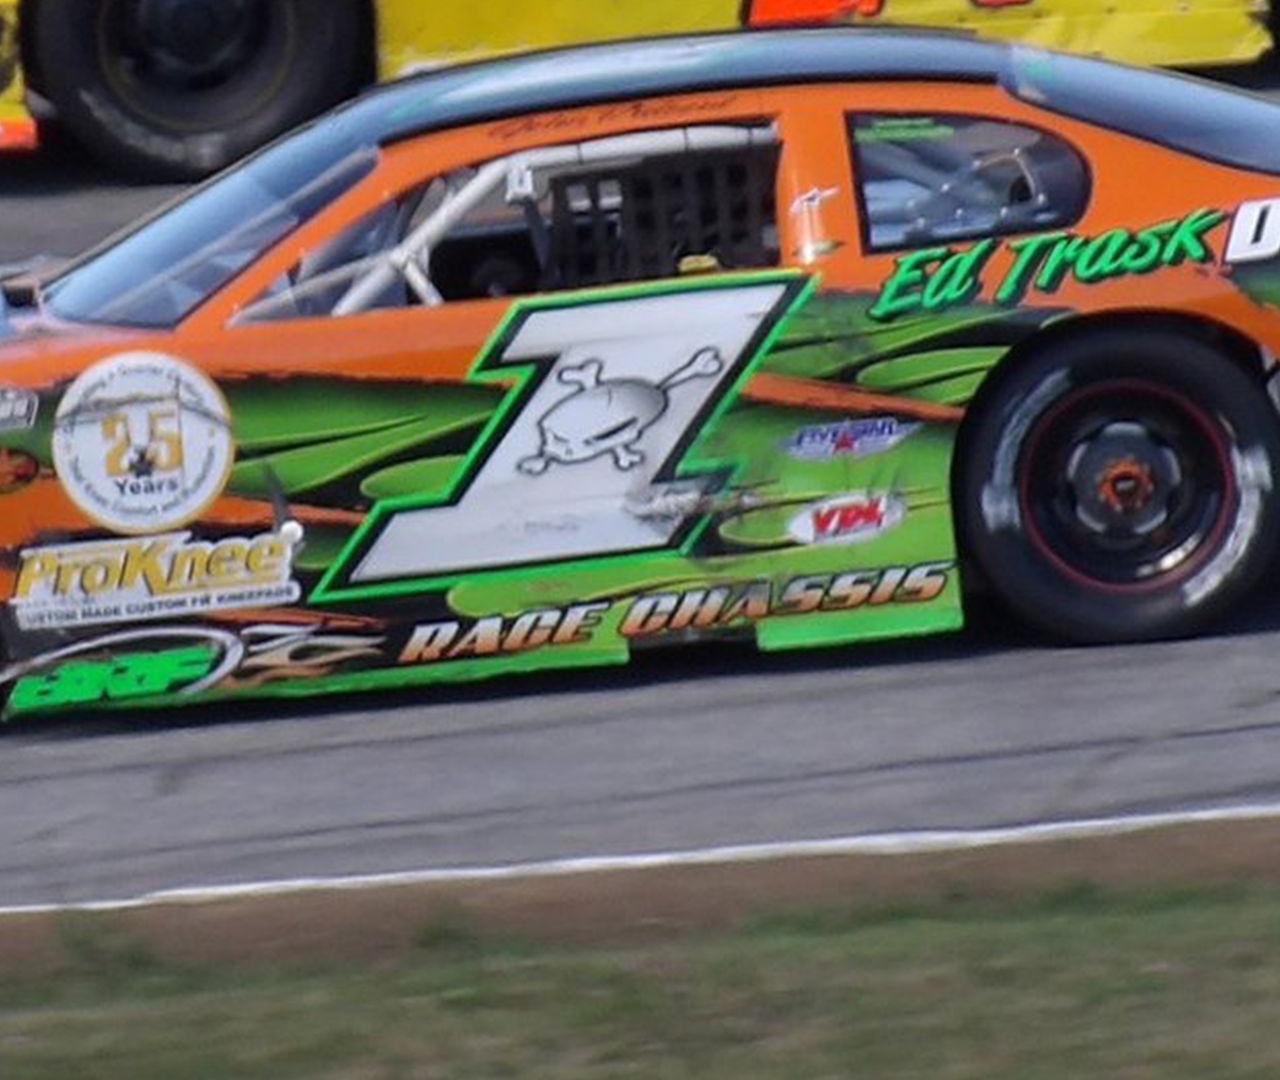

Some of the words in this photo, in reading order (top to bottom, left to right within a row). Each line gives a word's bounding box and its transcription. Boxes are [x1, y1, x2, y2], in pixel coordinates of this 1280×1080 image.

[868, 237, 996, 320] Ed
[992, 207, 1226, 306] Trask
[101, 411, 184, 477] 25
[323, 270, 818, 601] 1
[115, 477, 179, 496] Years
[16, 540, 286, 599] ProKnee
[81, 606, 122, 621] MADE
[125, 598, 188, 616] CUSTOM
[216, 587, 294, 604] KNEEPADS
[397, 600, 611, 664] RACE
[616, 558, 958, 636] CHASSIS
